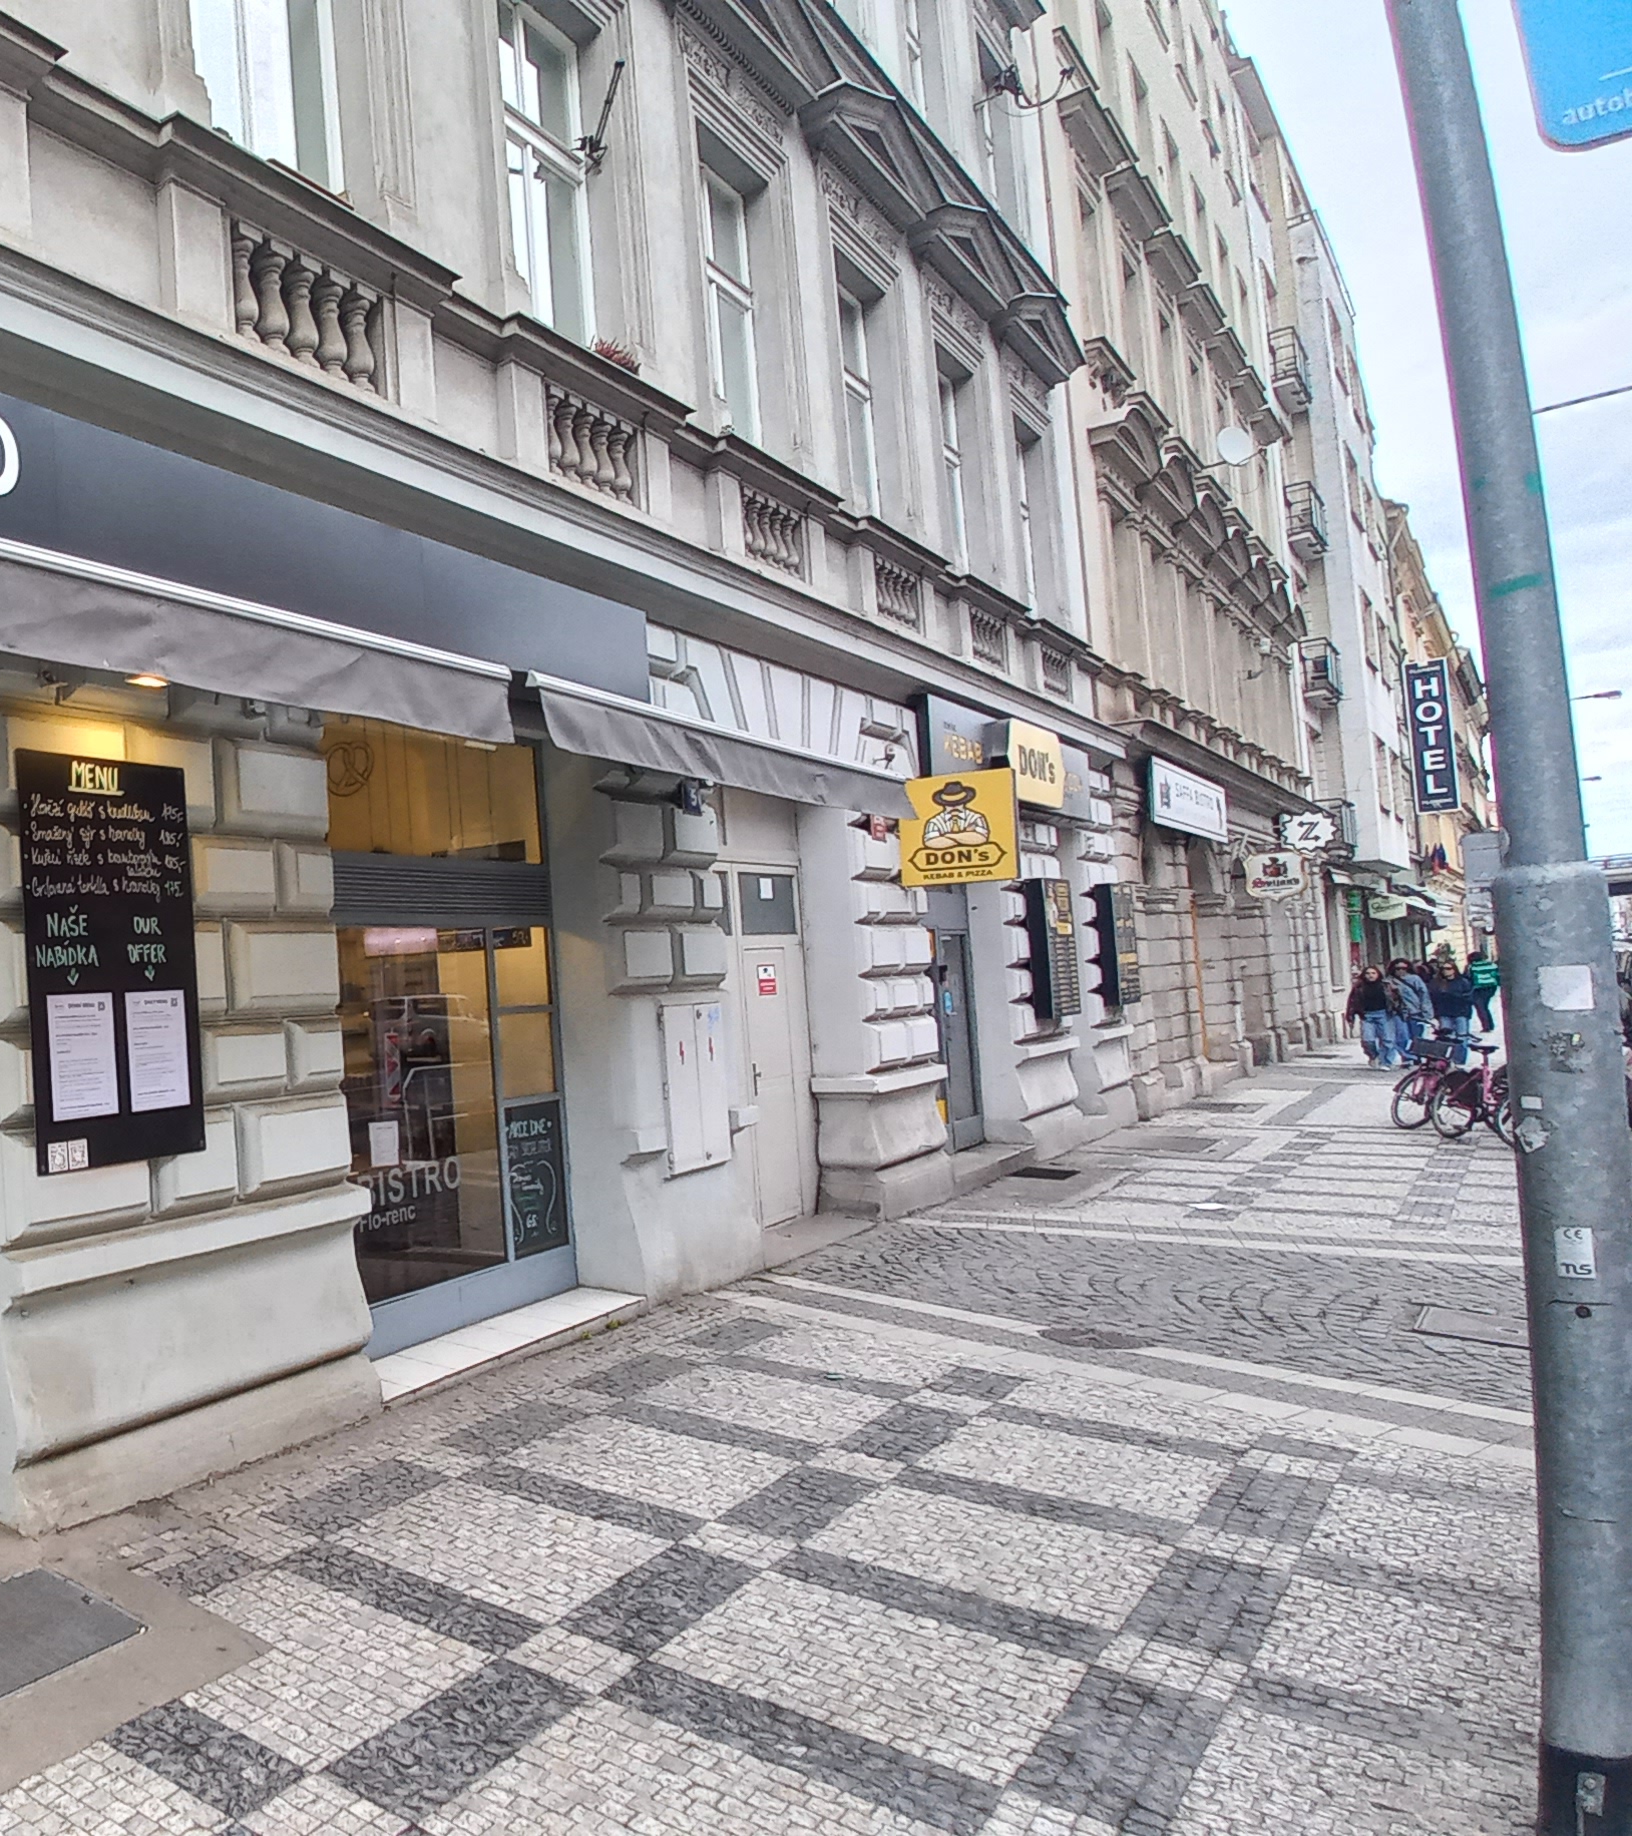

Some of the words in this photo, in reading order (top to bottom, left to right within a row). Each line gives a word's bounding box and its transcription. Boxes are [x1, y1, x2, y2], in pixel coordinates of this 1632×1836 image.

[1413, 678, 1449, 794] HOTEL
[1017, 744, 1055, 784] DON's
[71, 760, 118, 790] MENU
[99, 829, 106, 842] s
[97, 853, 104, 865] s
[925, 849, 990, 866] DON's
[923, 872, 955, 880] KEBAB
[965, 869, 993, 877] PIZZA
[46, 904, 88, 937] NAŠE
[133, 917, 162, 935] OUR
[35, 940, 99, 967] NABÍDKA
[127, 943, 167, 964] OFFER
